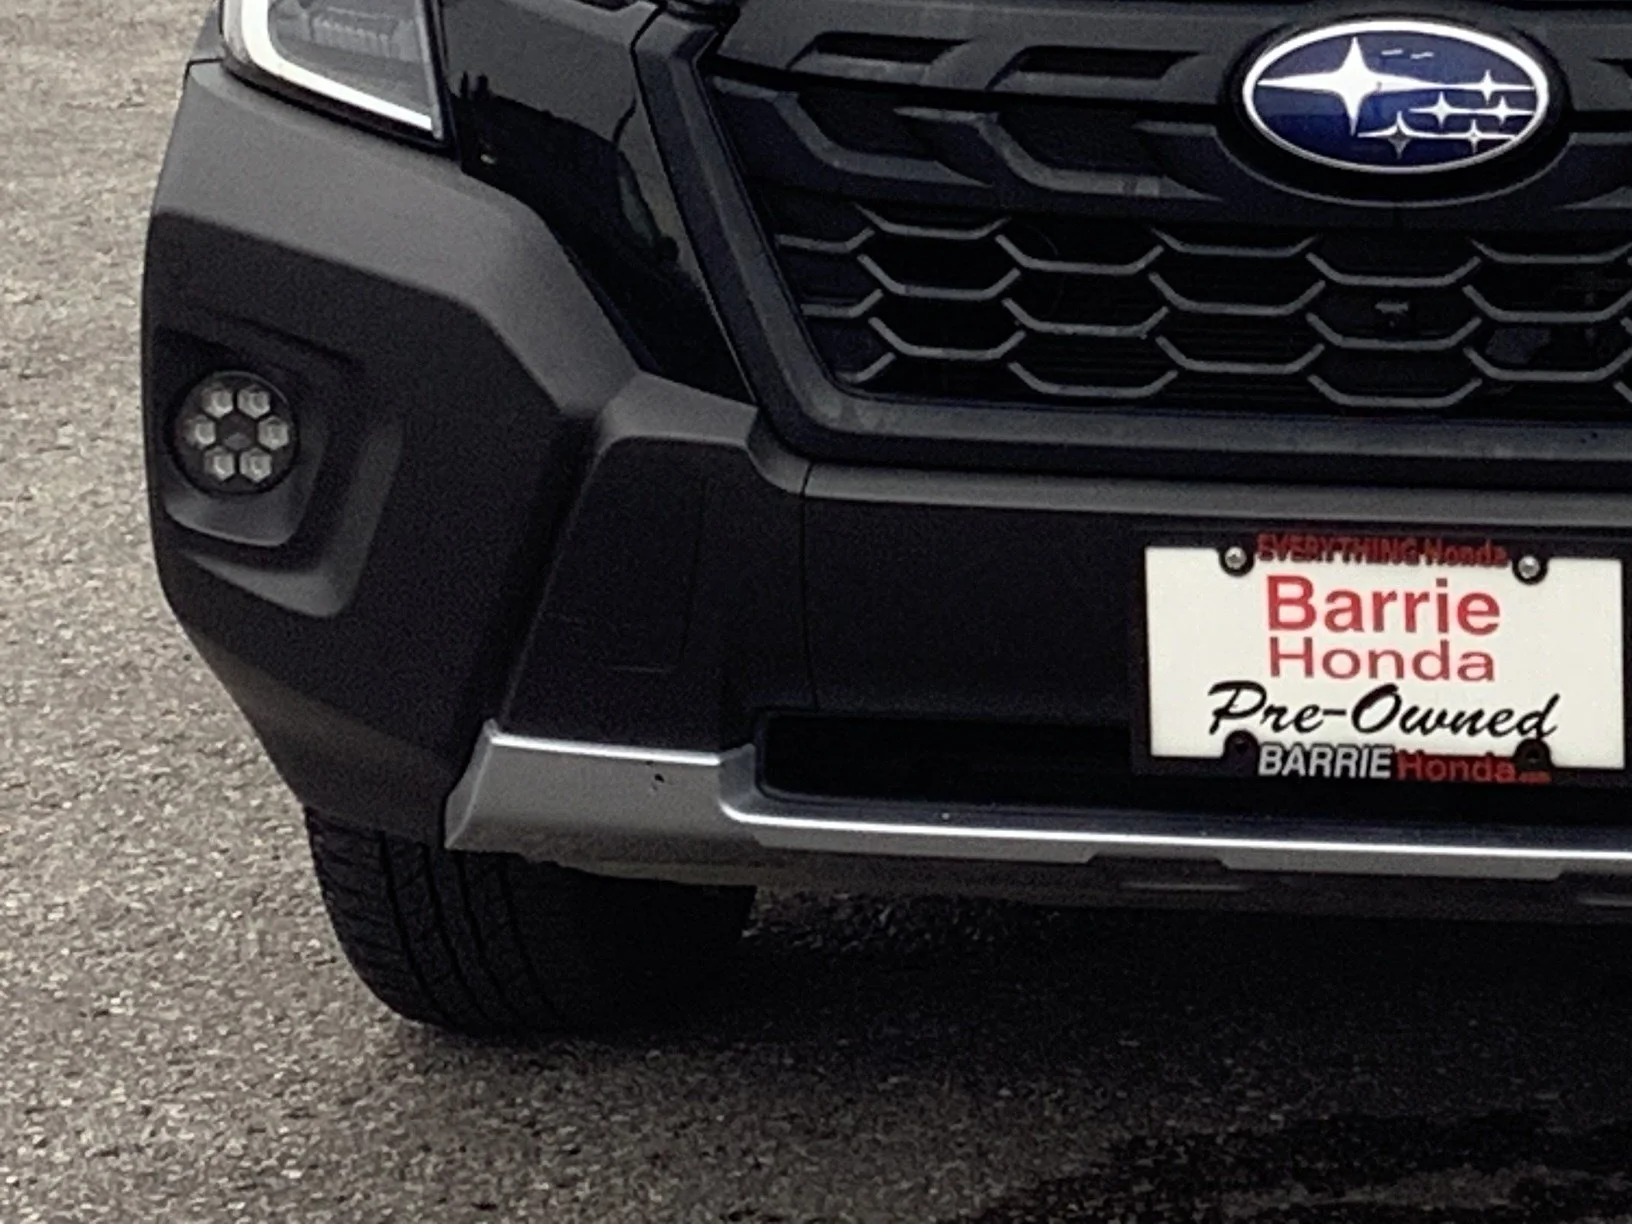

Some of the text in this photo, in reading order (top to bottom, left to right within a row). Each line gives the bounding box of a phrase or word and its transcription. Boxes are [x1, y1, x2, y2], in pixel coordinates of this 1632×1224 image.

[1257, 532, 1509, 567] EVERYTHING Honda
[1266, 574, 1501, 635] Barrie
[1269, 637, 1495, 682] Honda
[1207, 680, 1560, 739] Pre-Owned
[1257, 742, 1393, 778] BARRIE
